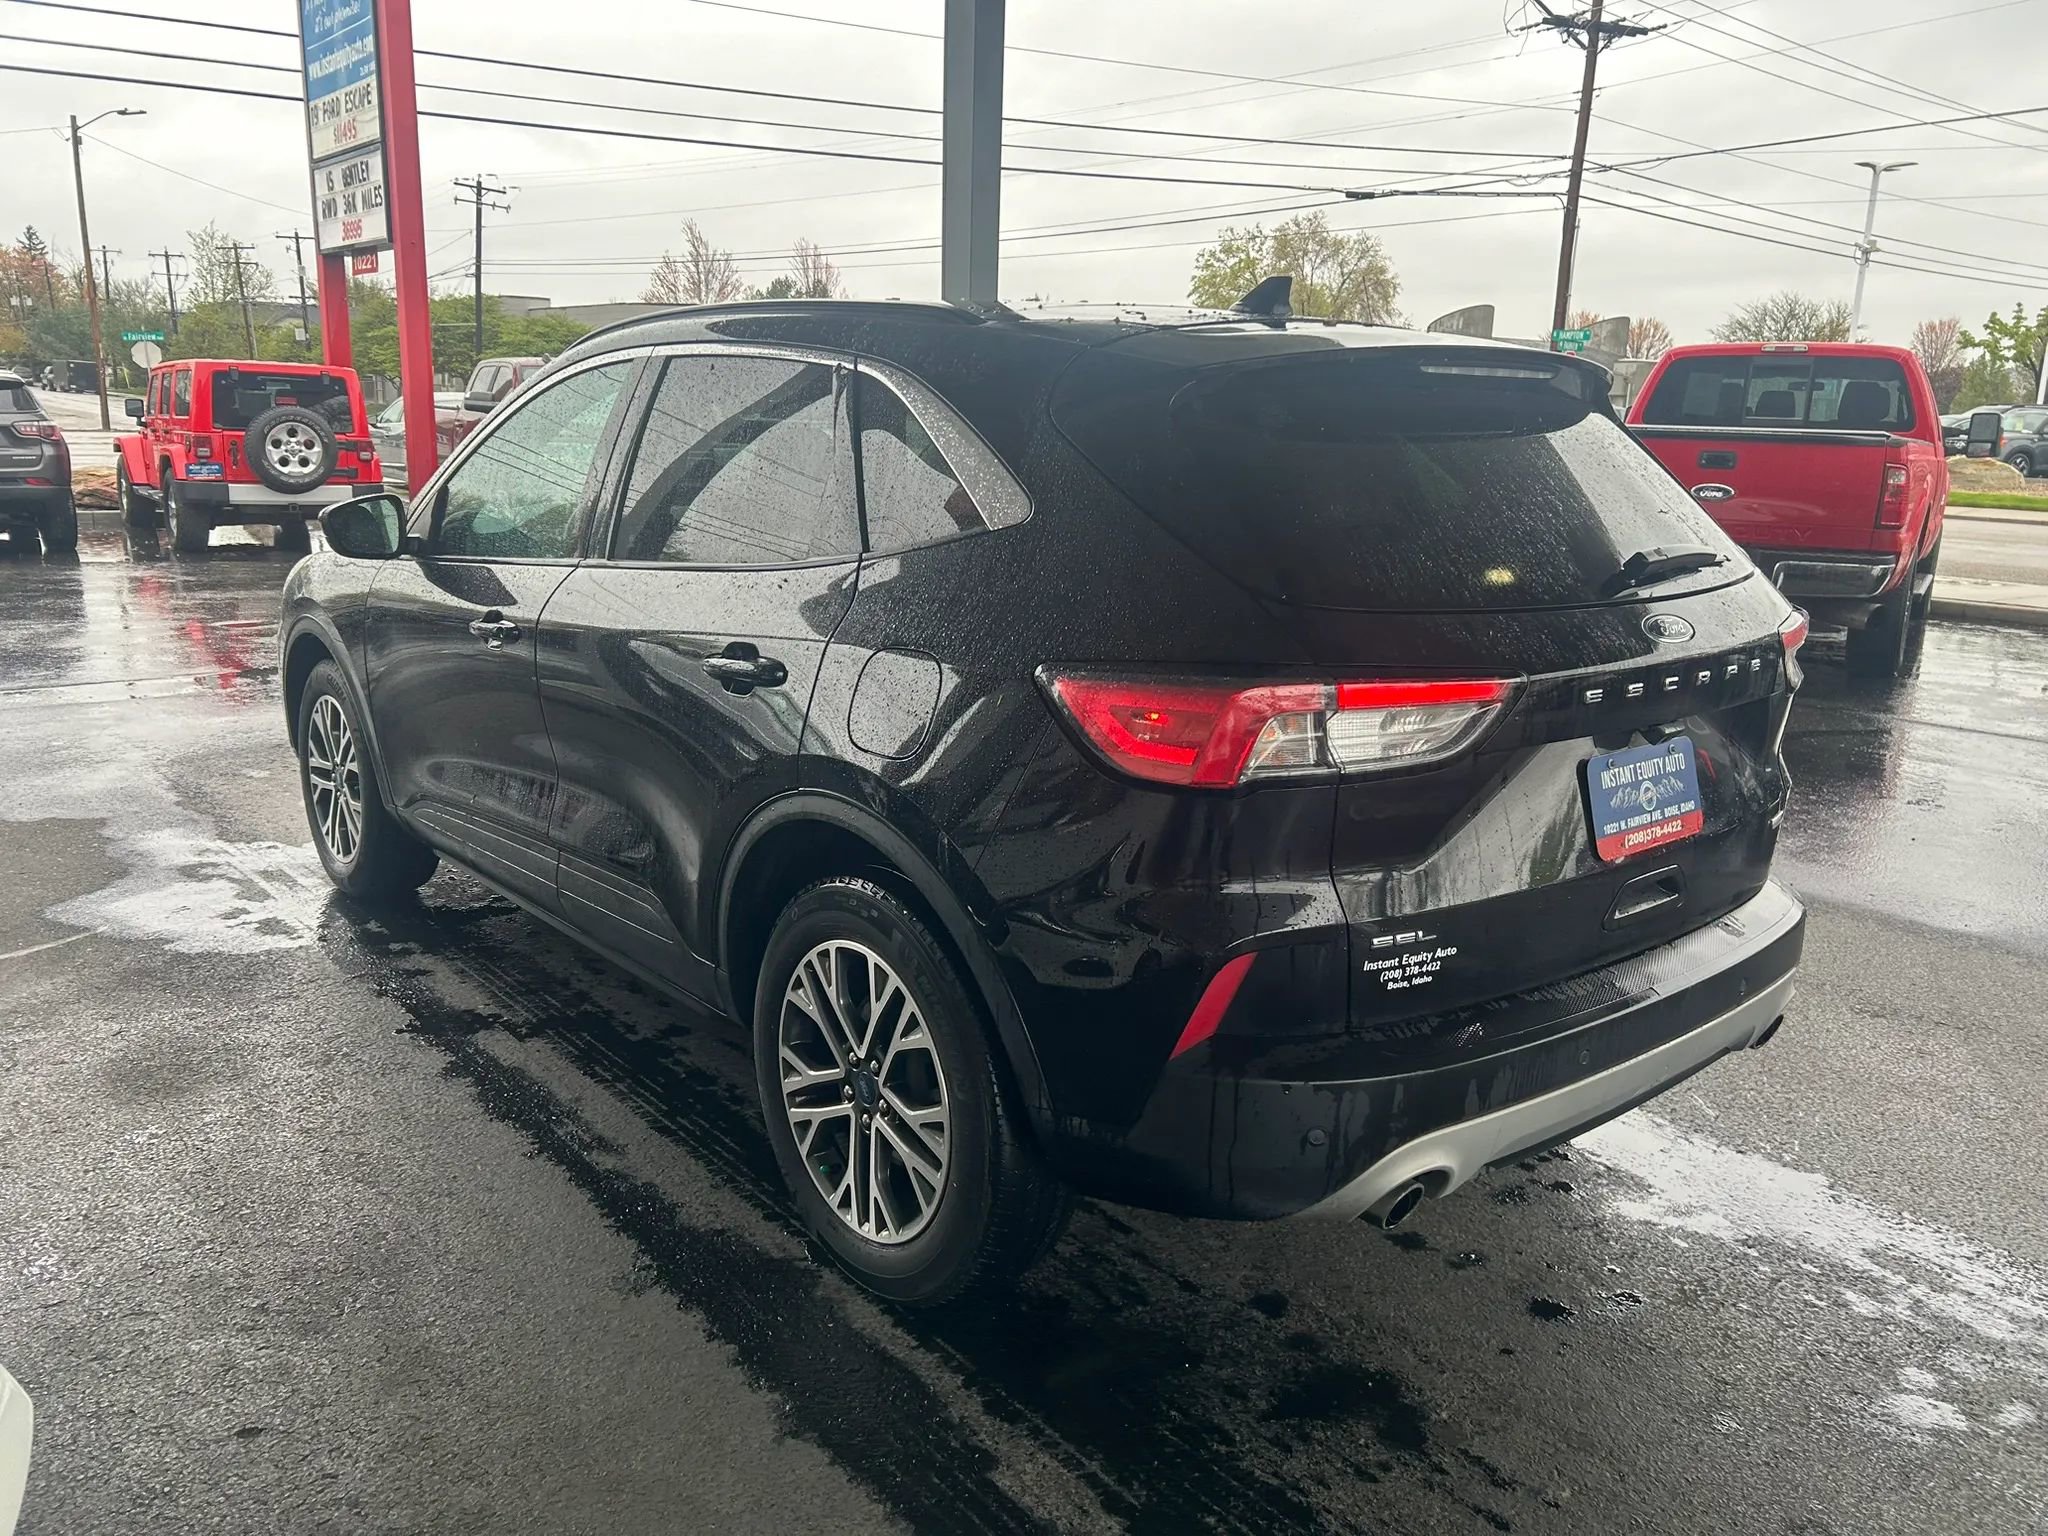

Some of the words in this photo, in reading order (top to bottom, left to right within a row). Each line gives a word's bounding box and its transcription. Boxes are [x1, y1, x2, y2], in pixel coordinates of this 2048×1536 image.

[311, 104, 320, 127] 19
[323, 96, 341, 122] FORD
[345, 83, 372, 113] ESCAPE
[341, 159, 370, 188] BENTLEY
[321, 197, 338, 219] RWD
[342, 192, 358, 215] 36K
[361, 185, 383, 211] MILES
[353, 254, 377, 271] 10221
[127, 332, 156, 341] Fairview
[1559, 330, 1584, 340] HAMPTON
[1699, 486, 1724, 498] Ford
[1657, 617, 1686, 636] Ford
[1584, 658, 1761, 704] ESCAPE
[1600, 764, 1636, 790] INSTANT
[1637, 756, 1664, 781] EQUITY
[1664, 752, 1686, 774] AUTO
[1603, 823, 1620, 836] 10221
[1627, 812, 1652, 828] FAIRVIEW
[1651, 811, 1663, 822] AVE.
[1680, 800, 1696, 813] IDAHO
[1623, 819, 1683, 849] (208)378-4422
[1370, 930, 1438, 950] SEL
[1363, 957, 1399, 971] Instant
[1402, 951, 1433, 966] Equity
[1434, 946, 1457, 959] Auto
[1380, 968, 1403, 983] (208)
[1404, 961, 1441, 978] 378-4422
[1387, 979, 1410, 990] Boise,
[1411, 974, 1433, 986] Idaho
